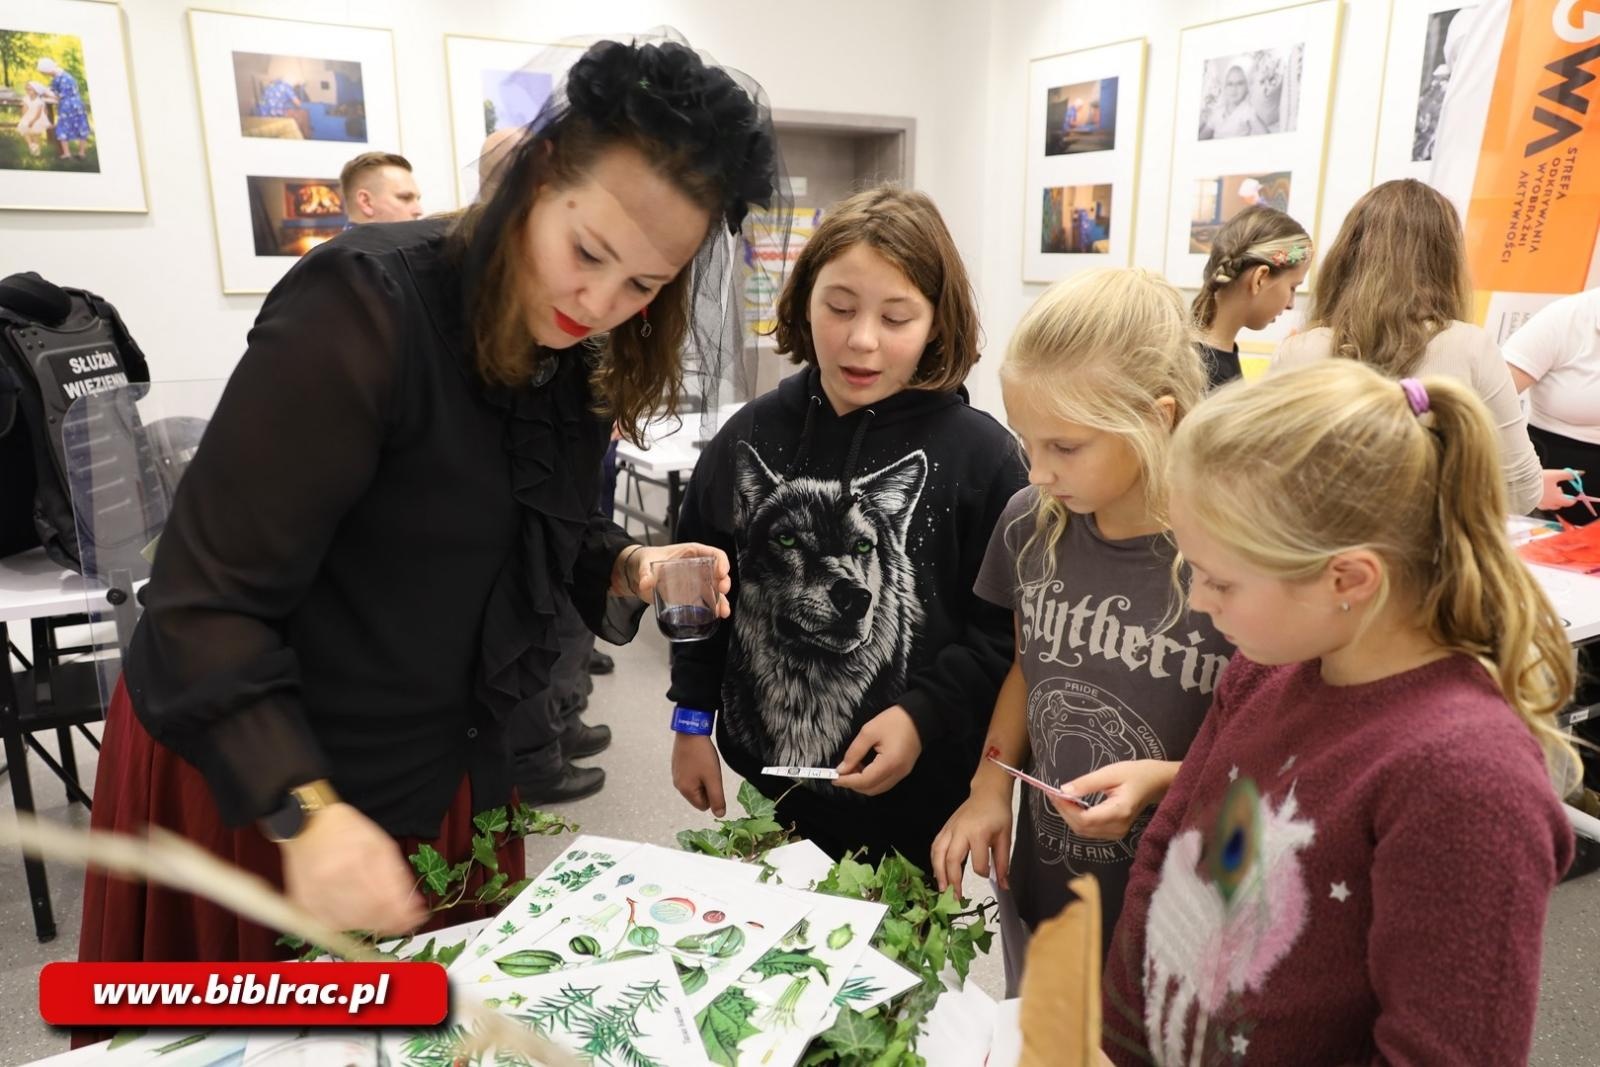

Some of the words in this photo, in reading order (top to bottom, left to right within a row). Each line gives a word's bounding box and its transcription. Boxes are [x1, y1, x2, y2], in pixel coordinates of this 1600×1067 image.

[1556, 147, 1578, 200] STREFA
[1501, 170, 1528, 264] AKTYWNOŚCI
[1528, 157, 1561, 253] ODKRYWANIA
[69, 350, 118, 375] SŁUŻBA
[1064, 681, 1099, 697] PRIDE
